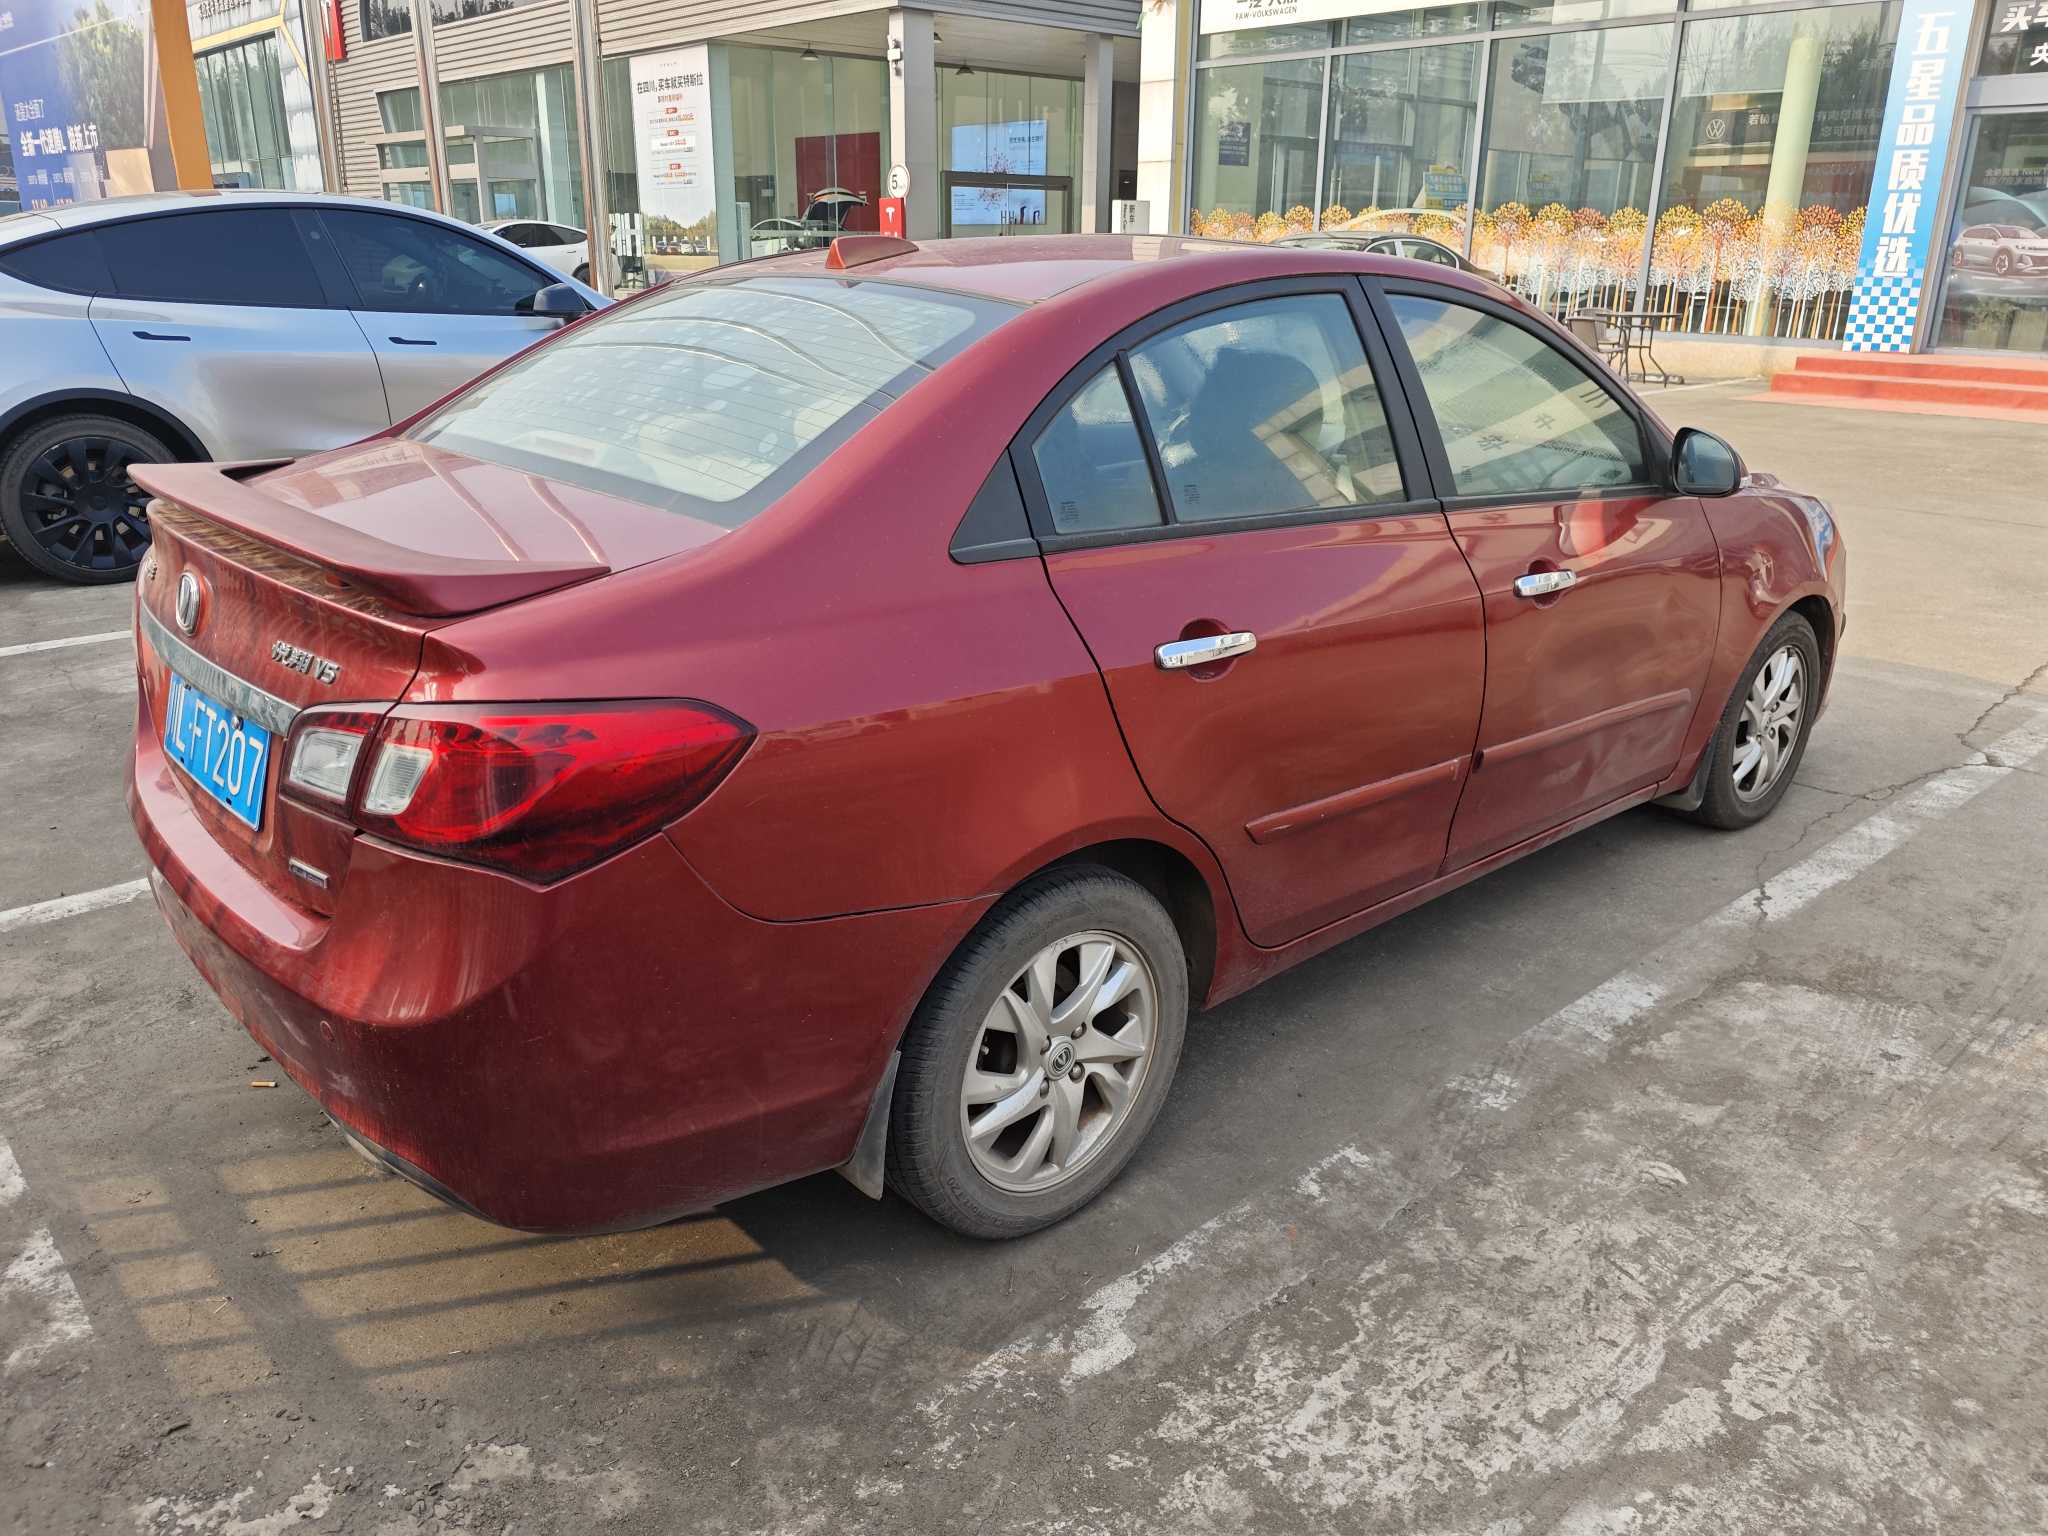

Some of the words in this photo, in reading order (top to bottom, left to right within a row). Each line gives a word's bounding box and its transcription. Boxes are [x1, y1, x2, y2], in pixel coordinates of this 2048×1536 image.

[1235, 7, 1297, 20] FAW-VOLKSWAGEN
[1873, 10, 1956, 277] 五星品质优选
[891, 174, 898, 190] 5
[314, 657, 341, 686] V5
